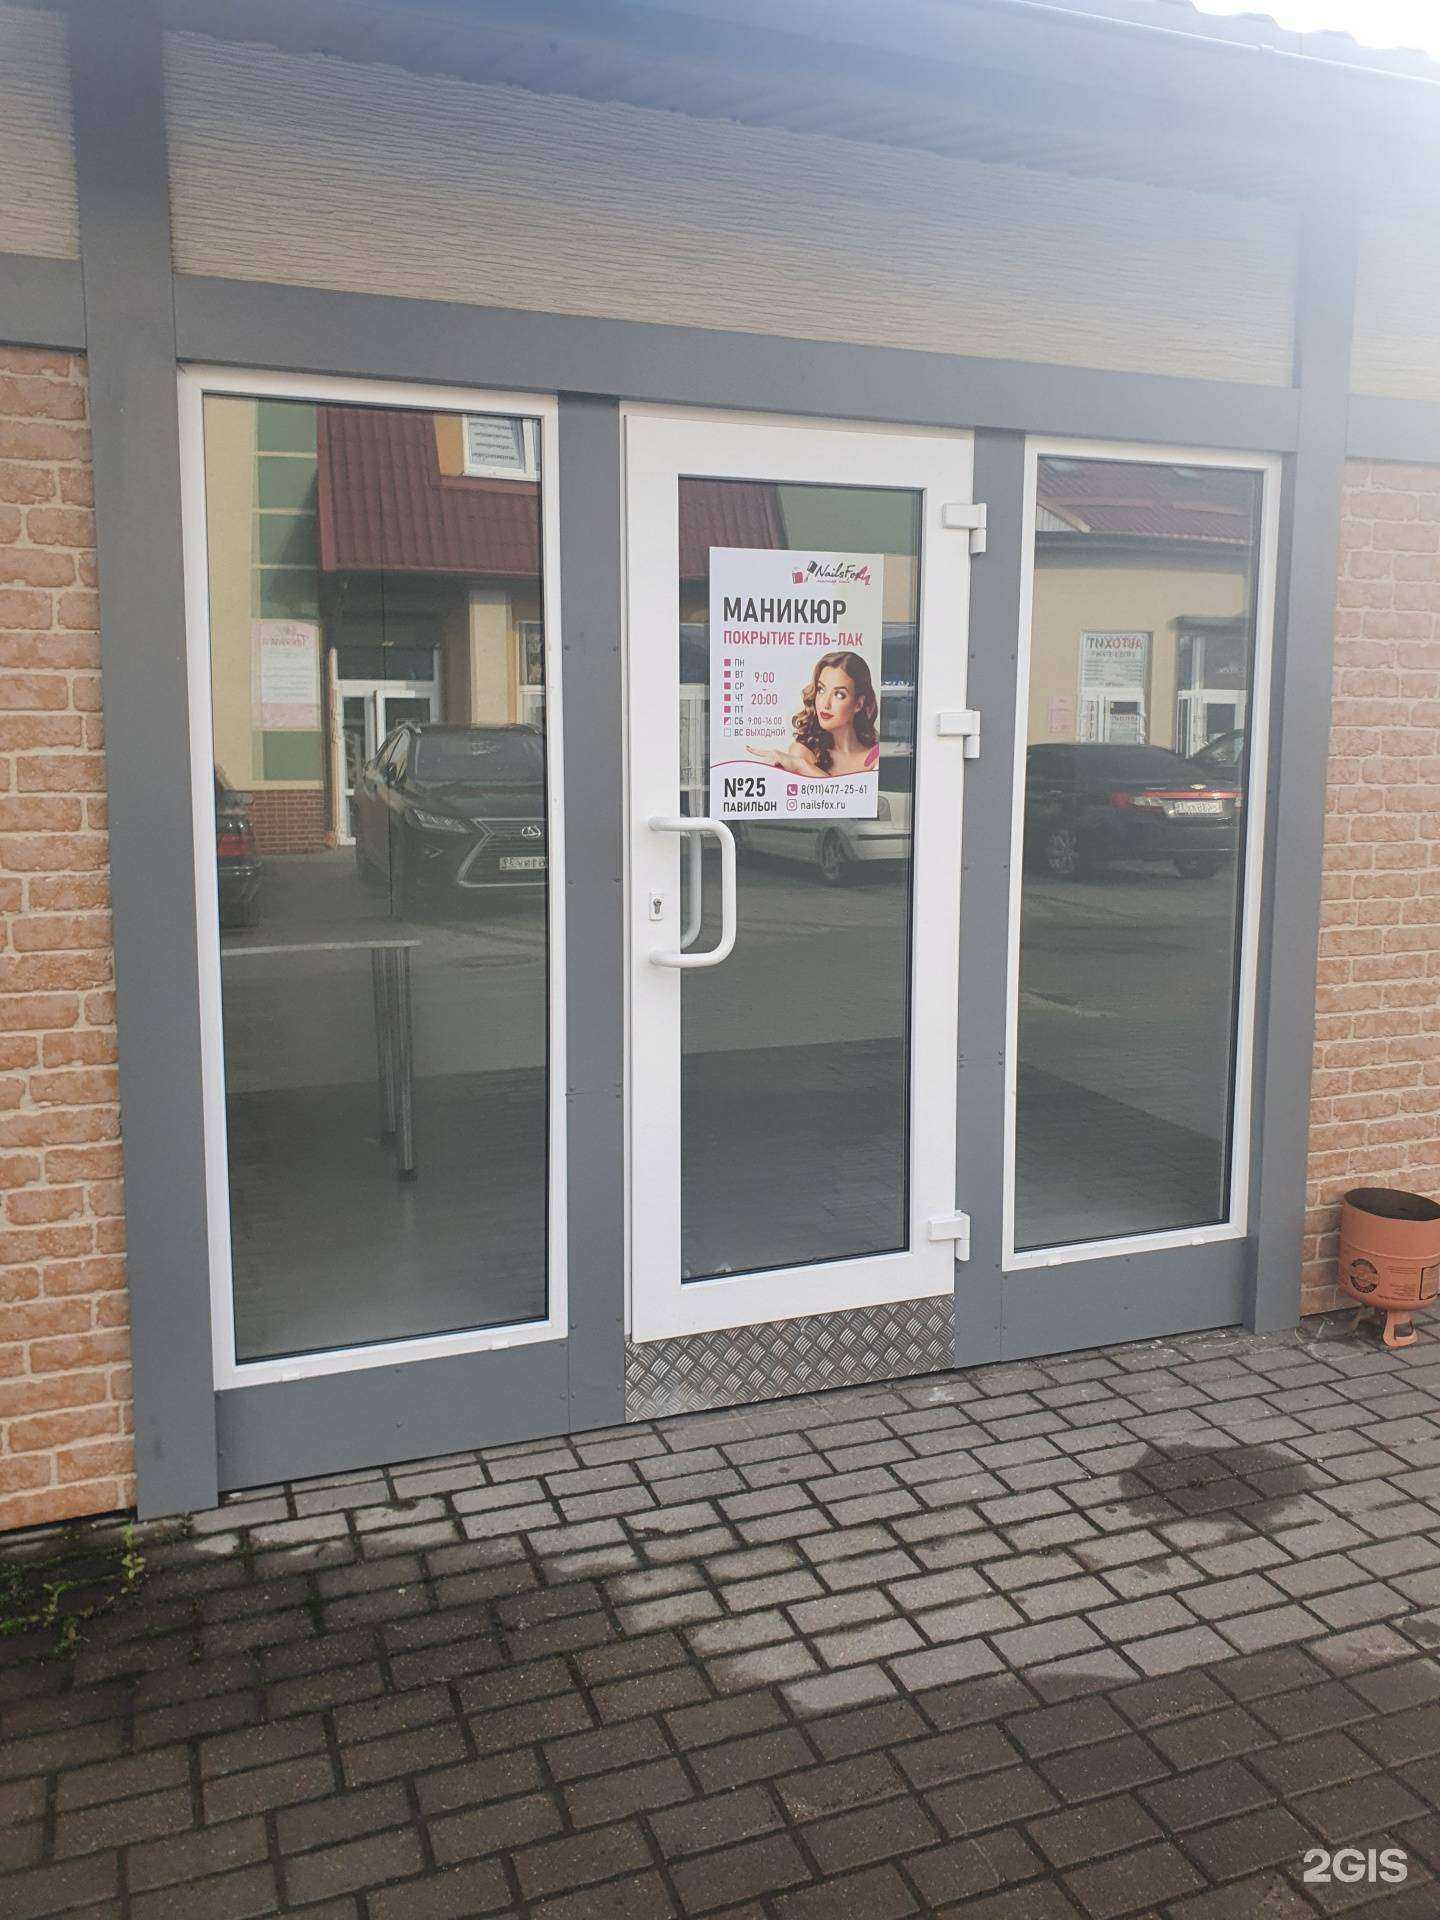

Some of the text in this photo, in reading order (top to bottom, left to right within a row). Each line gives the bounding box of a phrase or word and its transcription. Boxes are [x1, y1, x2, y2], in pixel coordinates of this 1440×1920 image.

[723, 597, 847, 624] МАНИКЮР
[723, 630, 863, 646] ПОКРЫТИЕ ГЕЛЬ-ЛАК
[734, 659, 745, 667] ПН
[754, 672, 775, 683] 9:00
[734, 694, 744, 702] ЧТ
[751, 693, 778, 705] 20:00
[734, 717, 744, 725] СБ
[745, 728, 786, 737] ВЫХОДНОЙ
[724, 777, 766, 798] №25
[723, 801, 777, 813] ПАВИЛЬОН
[800, 800, 846, 810] nailsfox.ru
